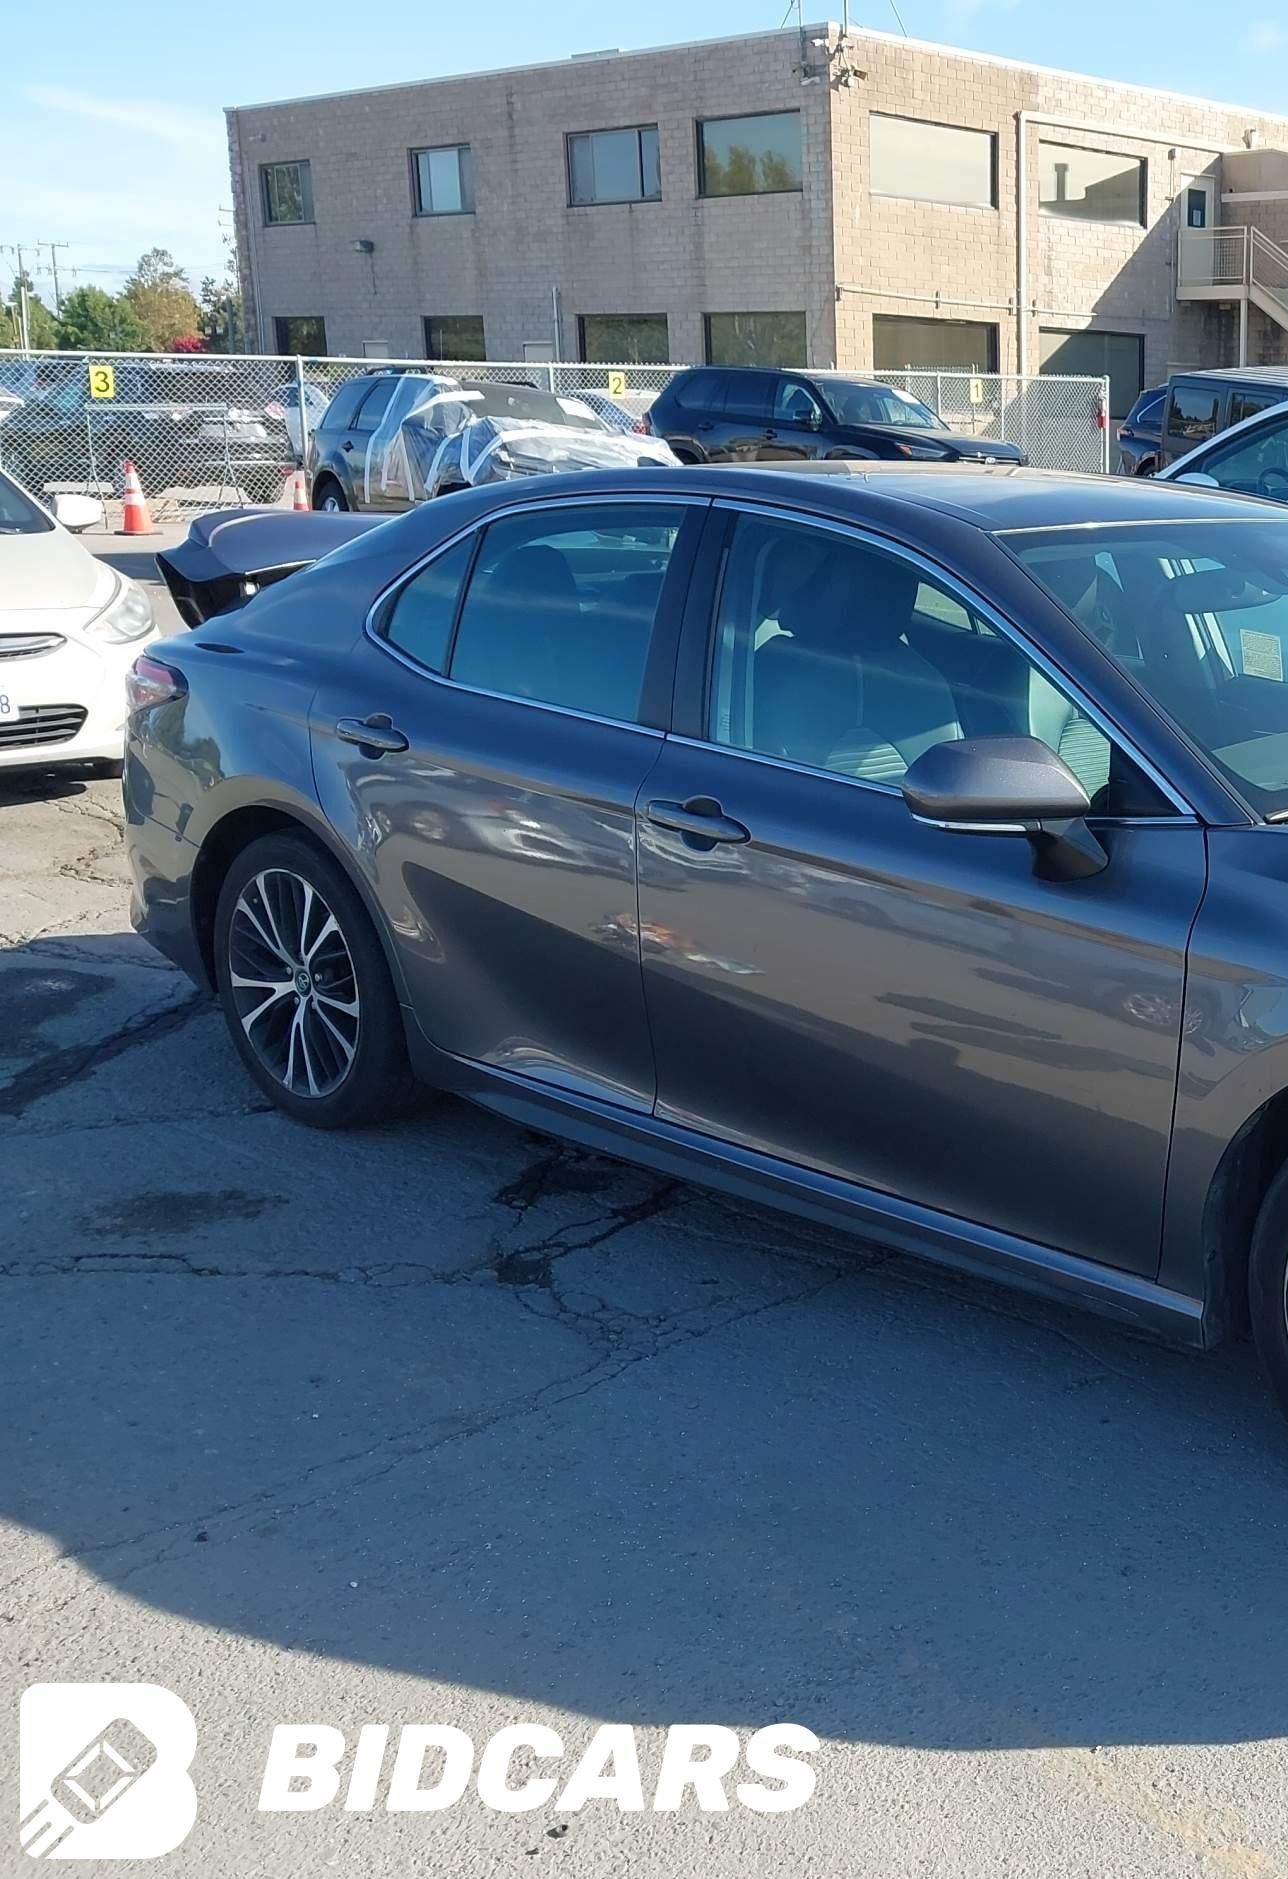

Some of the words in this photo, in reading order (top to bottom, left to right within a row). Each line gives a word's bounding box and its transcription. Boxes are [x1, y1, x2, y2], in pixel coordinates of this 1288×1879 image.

[95, 371, 110, 393] 3
[612, 377, 622, 395] 2
[0, 694, 10, 714] 8
